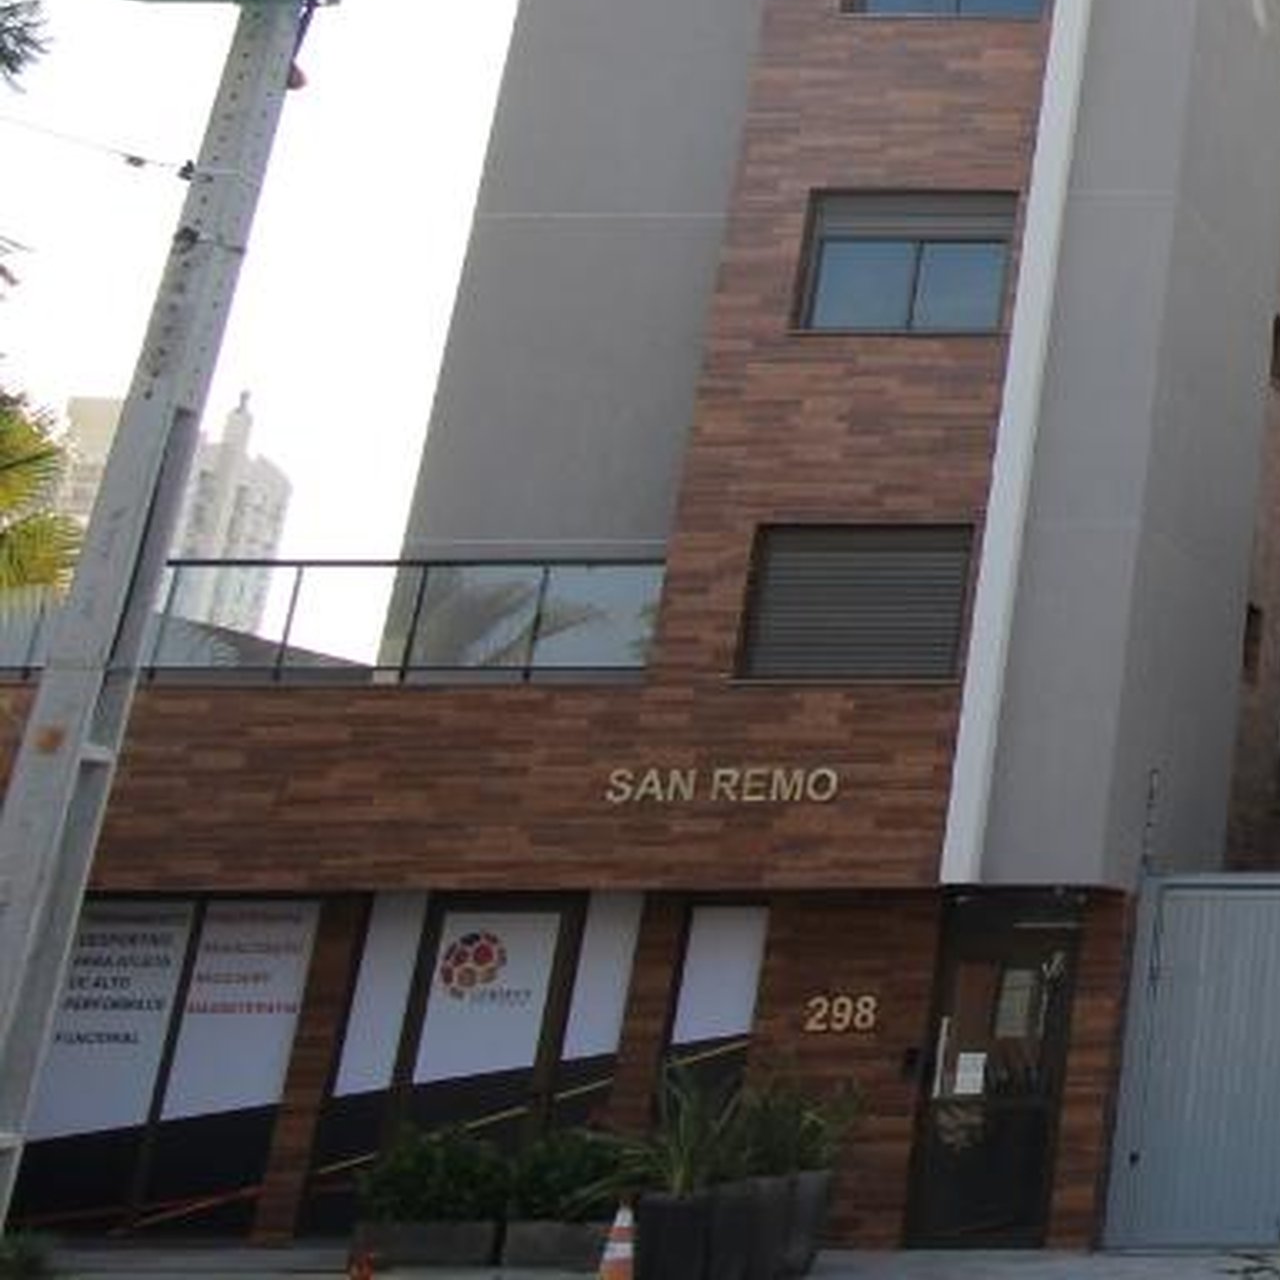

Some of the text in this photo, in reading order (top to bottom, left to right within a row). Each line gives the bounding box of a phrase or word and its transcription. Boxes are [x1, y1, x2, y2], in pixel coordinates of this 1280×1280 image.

[605, 767, 838, 802] SAN REMO
[804, 995, 878, 1031] 298
